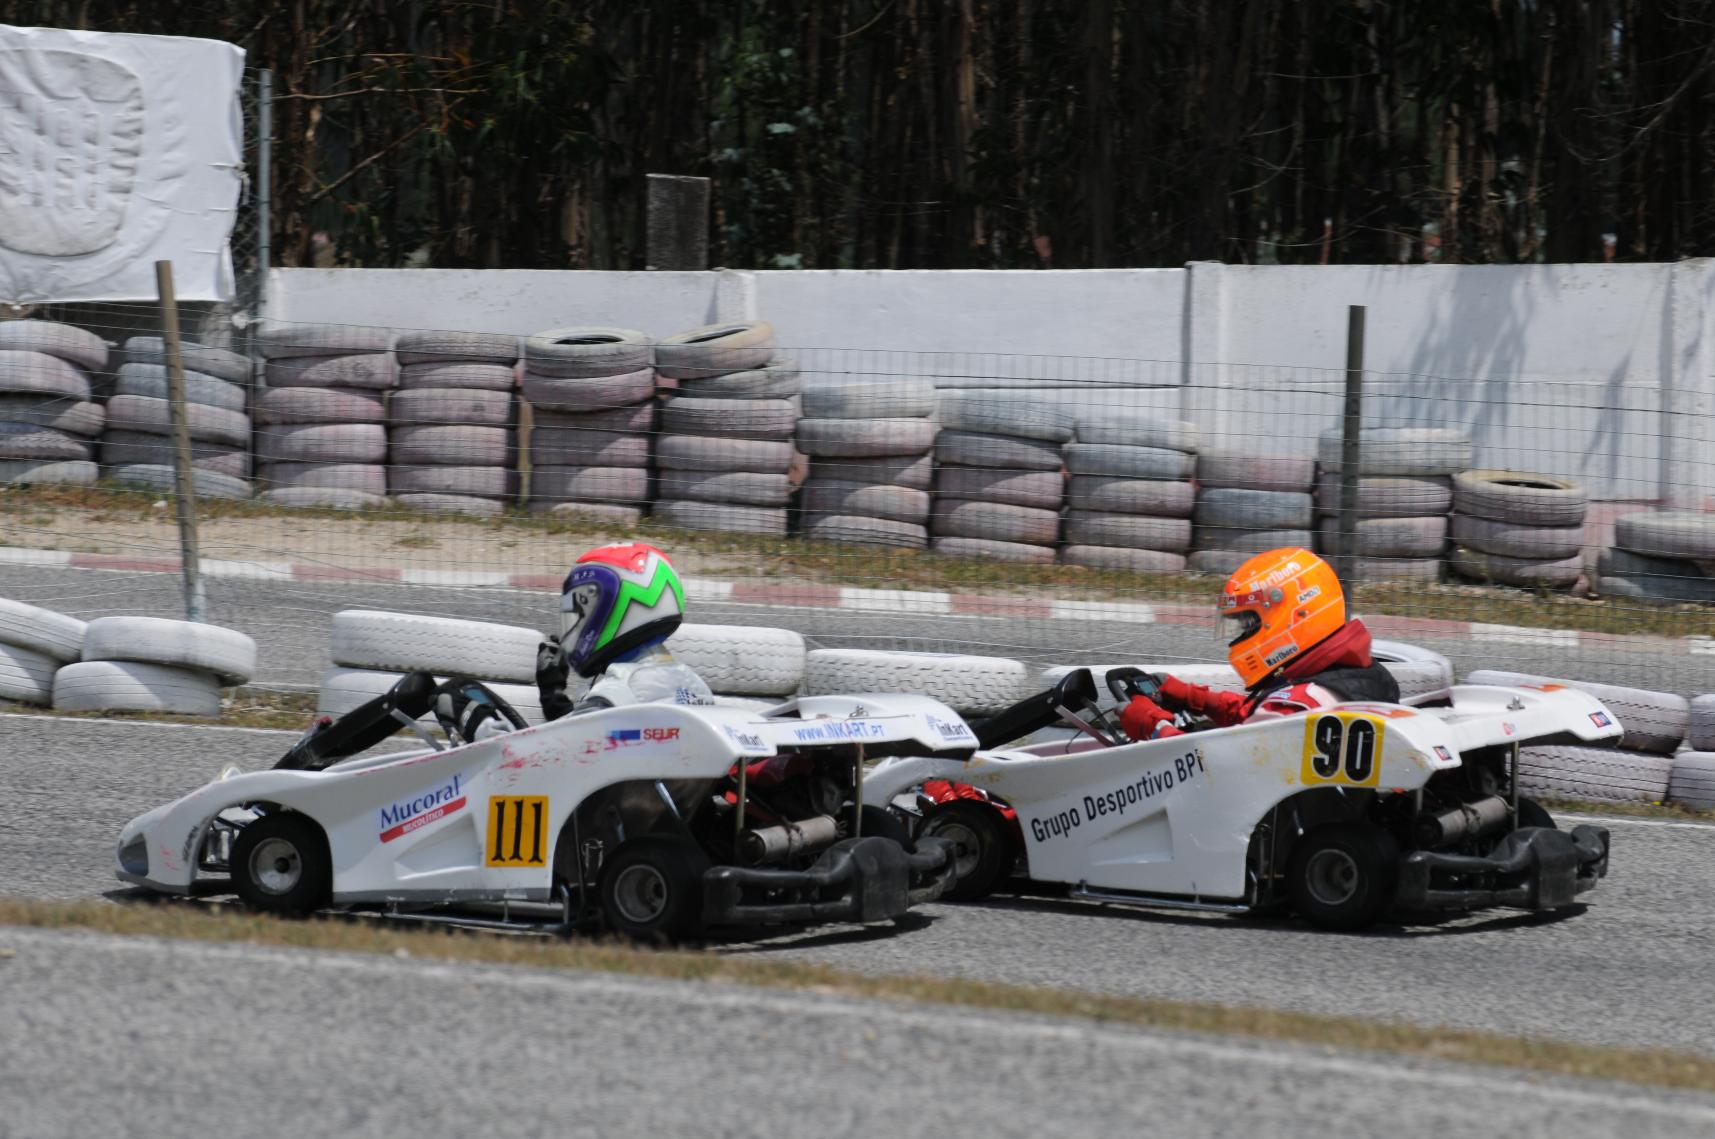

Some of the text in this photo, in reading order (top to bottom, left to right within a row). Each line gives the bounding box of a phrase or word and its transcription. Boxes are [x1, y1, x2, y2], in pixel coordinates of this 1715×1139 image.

[643, 728, 680, 741] SEUR
[1312, 714, 1376, 782] 90
[381, 775, 460, 829] Mucoral
[491, 799, 543, 864] 111
[1031, 807, 1081, 842] Grupo
[1083, 770, 1173, 821] Desportivo
